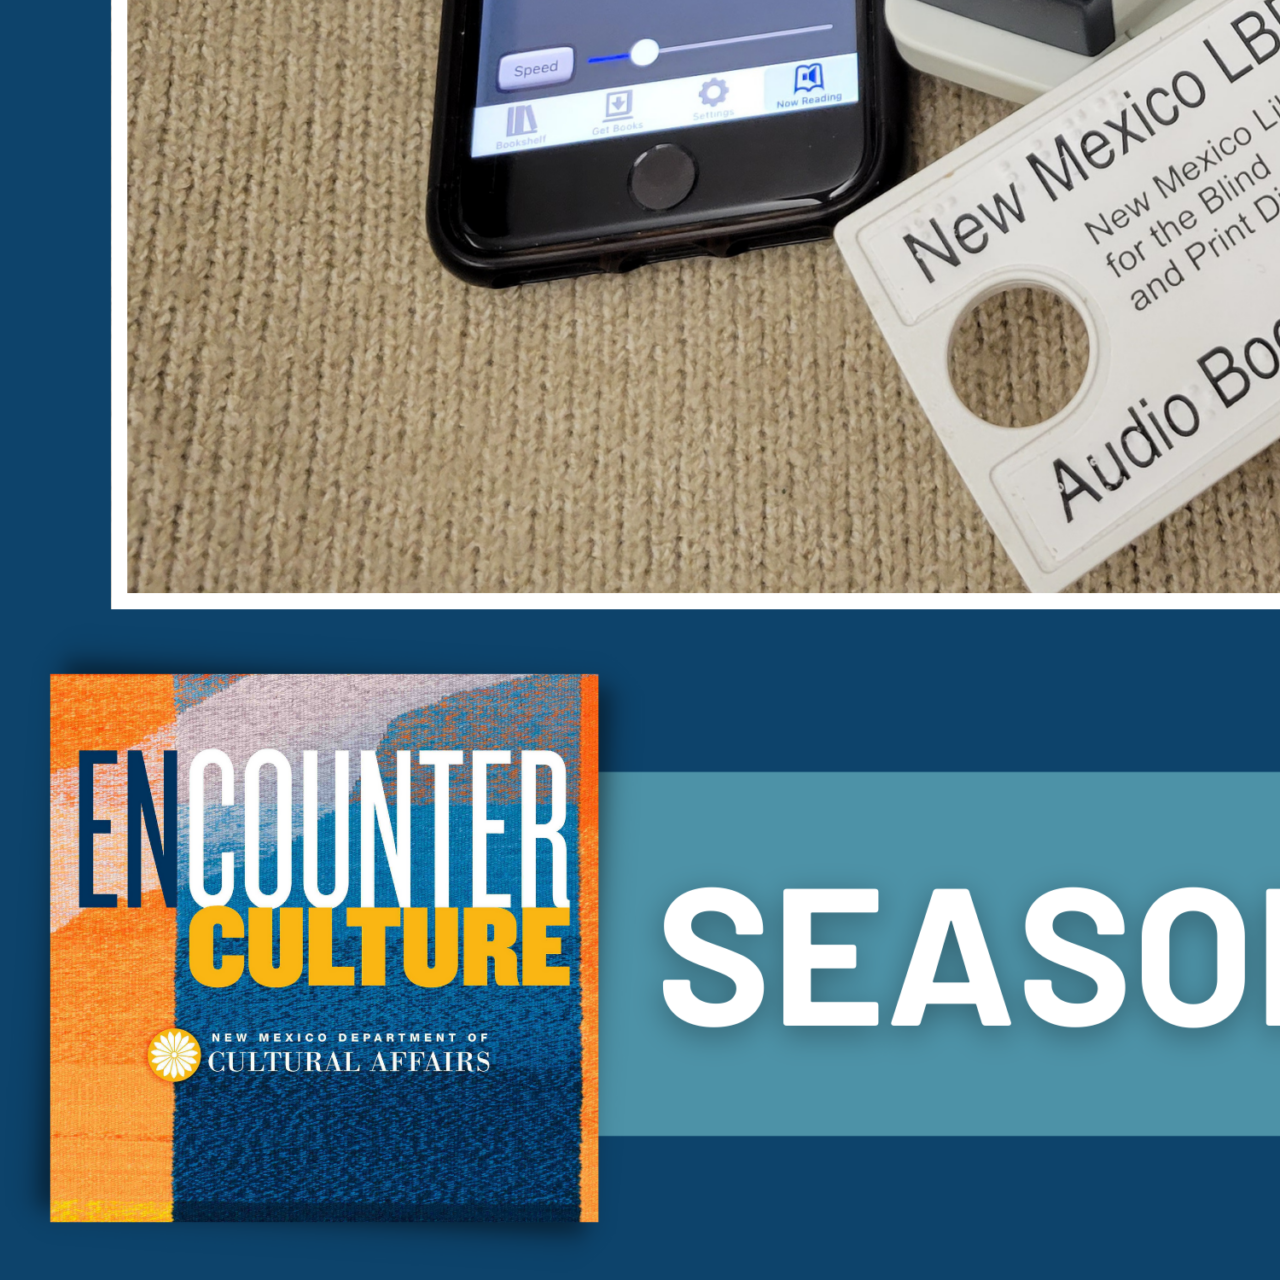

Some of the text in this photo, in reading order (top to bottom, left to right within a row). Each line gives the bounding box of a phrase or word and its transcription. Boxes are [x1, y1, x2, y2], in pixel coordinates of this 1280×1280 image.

[514, 61, 558, 78] Speed
[592, 121, 643, 136] Get Books
[693, 108, 734, 121] Settings
[777, 92, 842, 109] Now Reading
[496, 135, 547, 149] Bookshelf
[902, 182, 1026, 284] New
[1026, 69, 1206, 202] Mexico
[1084, 193, 1151, 245] New
[1152, 127, 1252, 201] Mexico
[1105, 154, 1271, 279] for the Blind
[1131, 260, 1185, 311] and
[1185, 212, 1256, 272] Print
[1049, 396, 1200, 523] Audio
